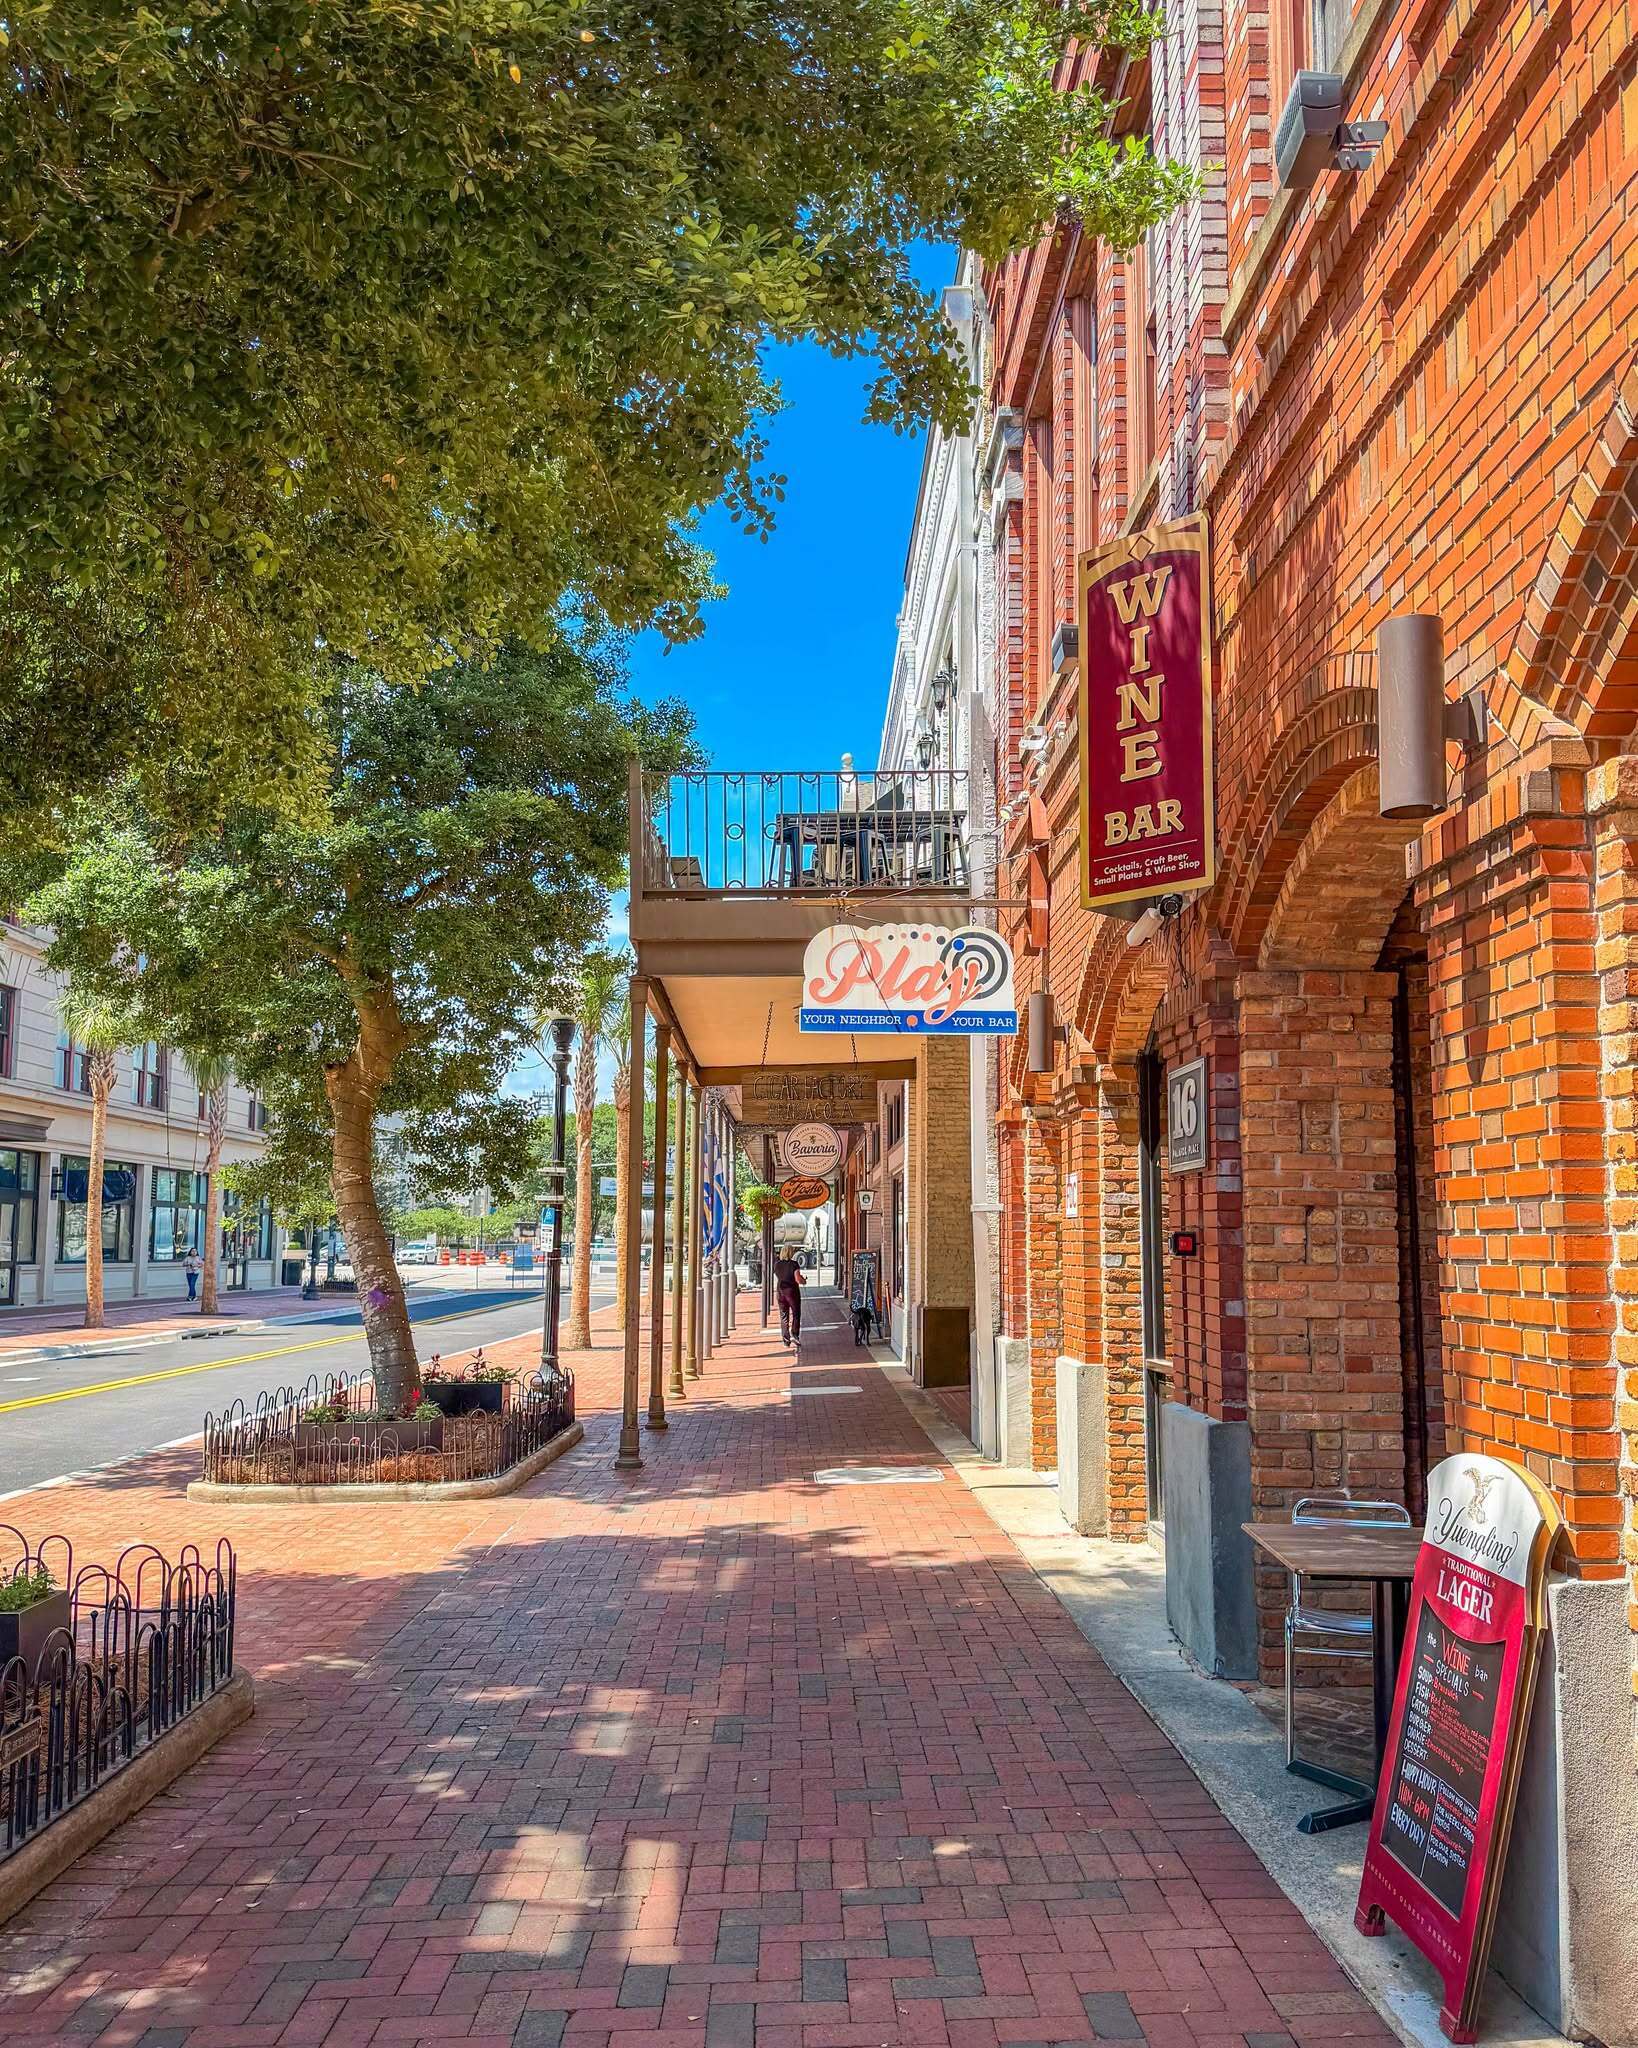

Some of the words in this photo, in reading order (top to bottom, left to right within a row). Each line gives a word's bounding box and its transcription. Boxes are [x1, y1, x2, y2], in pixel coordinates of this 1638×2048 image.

[1107, 565, 1172, 782] WINE
[1104, 799, 1184, 846] BAR
[1094, 874, 1116, 886] Small
[1118, 871, 1143, 881] Plates
[1145, 868, 1152, 877] &
[1154, 864, 1177, 875] Wine
[1178, 860, 1200, 871] Shop
[1104, 861, 1142, 875] Cocktails,
[1144, 855, 1166, 867] Craft
[1167, 853, 1189, 863] Beer,
[808, 938, 983, 1025] Play
[803, 1014, 835, 1024] YOUR
[839, 1015, 902, 1025] NEIGHBOR
[952, 1016, 984, 1026] YOUR
[988, 1016, 1013, 1027] BAR
[1172, 1078, 1197, 1139] 16
[789, 1139, 838, 1157] Bavaria
[1433, 1497, 1518, 1573] Yuengling
[1446, 1557, 1492, 1588] TRADITIONAL
[1436, 1569, 1495, 1625] LAGER
[1427, 1631, 1437, 1648] the
[1442, 1629, 1471, 1676] WINE
[1474, 1664, 1488, 1682] bar
[1435, 1659, 1470, 1697] SPECIALS
[1418, 1769, 1437, 1796] HOUR
[1408, 1820, 1427, 1848] DAY
